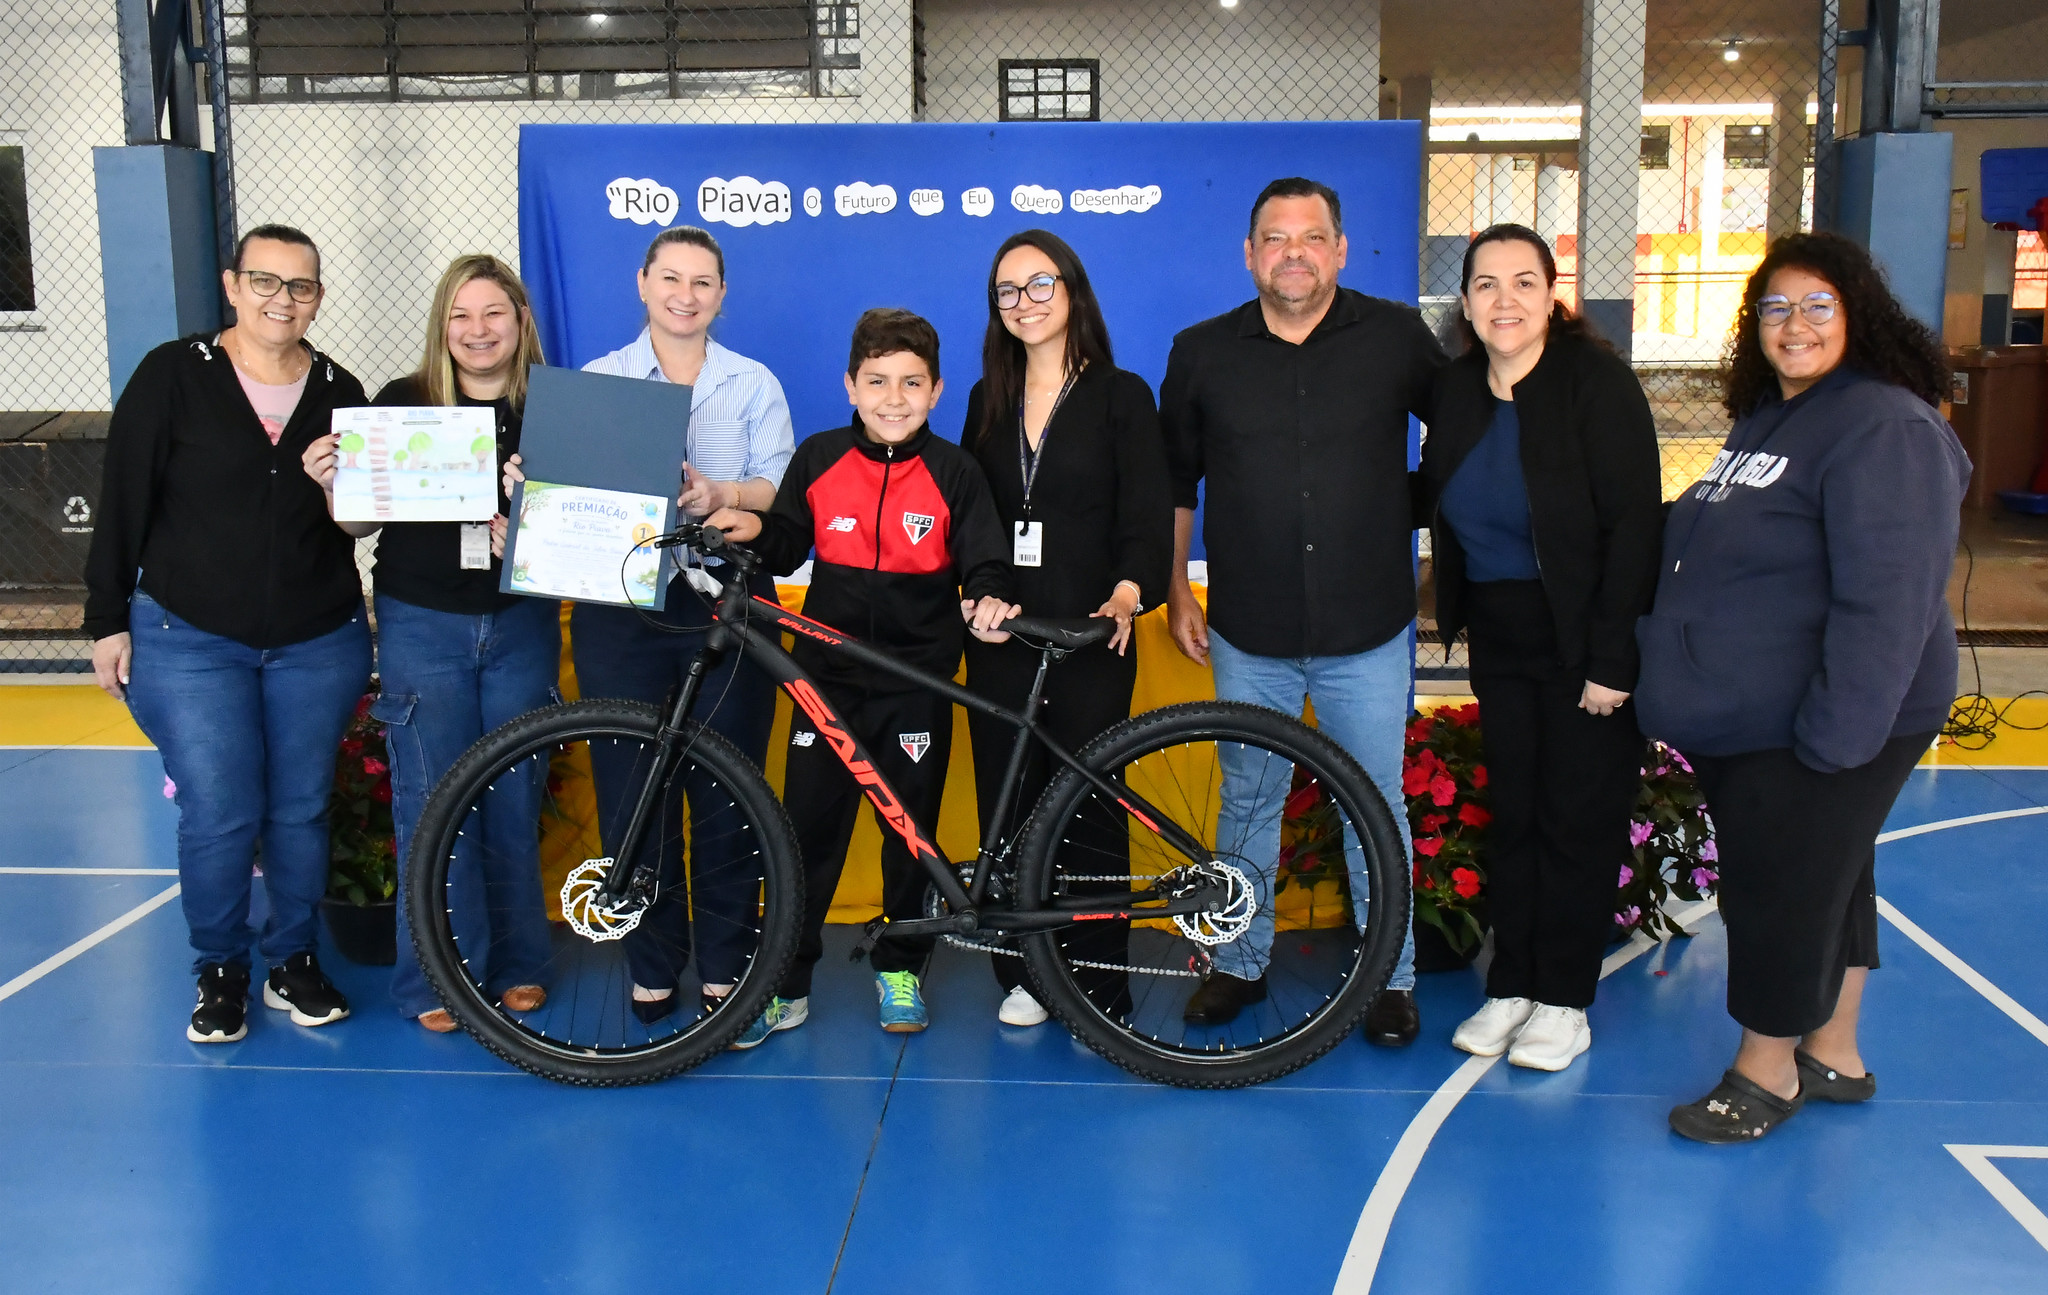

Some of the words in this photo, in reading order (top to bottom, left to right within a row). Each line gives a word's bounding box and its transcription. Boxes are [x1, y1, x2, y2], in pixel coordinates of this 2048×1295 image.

[702, 186, 789, 214] Piava:
[806, 194, 818, 210] O
[842, 194, 890, 209] Futuro
[911, 190, 940, 205] que
[968, 190, 987, 204] Eu
[1014, 192, 1060, 210] Quero
[561, 501, 628, 521] PREMIAÇÃO
[906, 515, 931, 526] SPFC
[903, 735, 927, 743] SPFC
